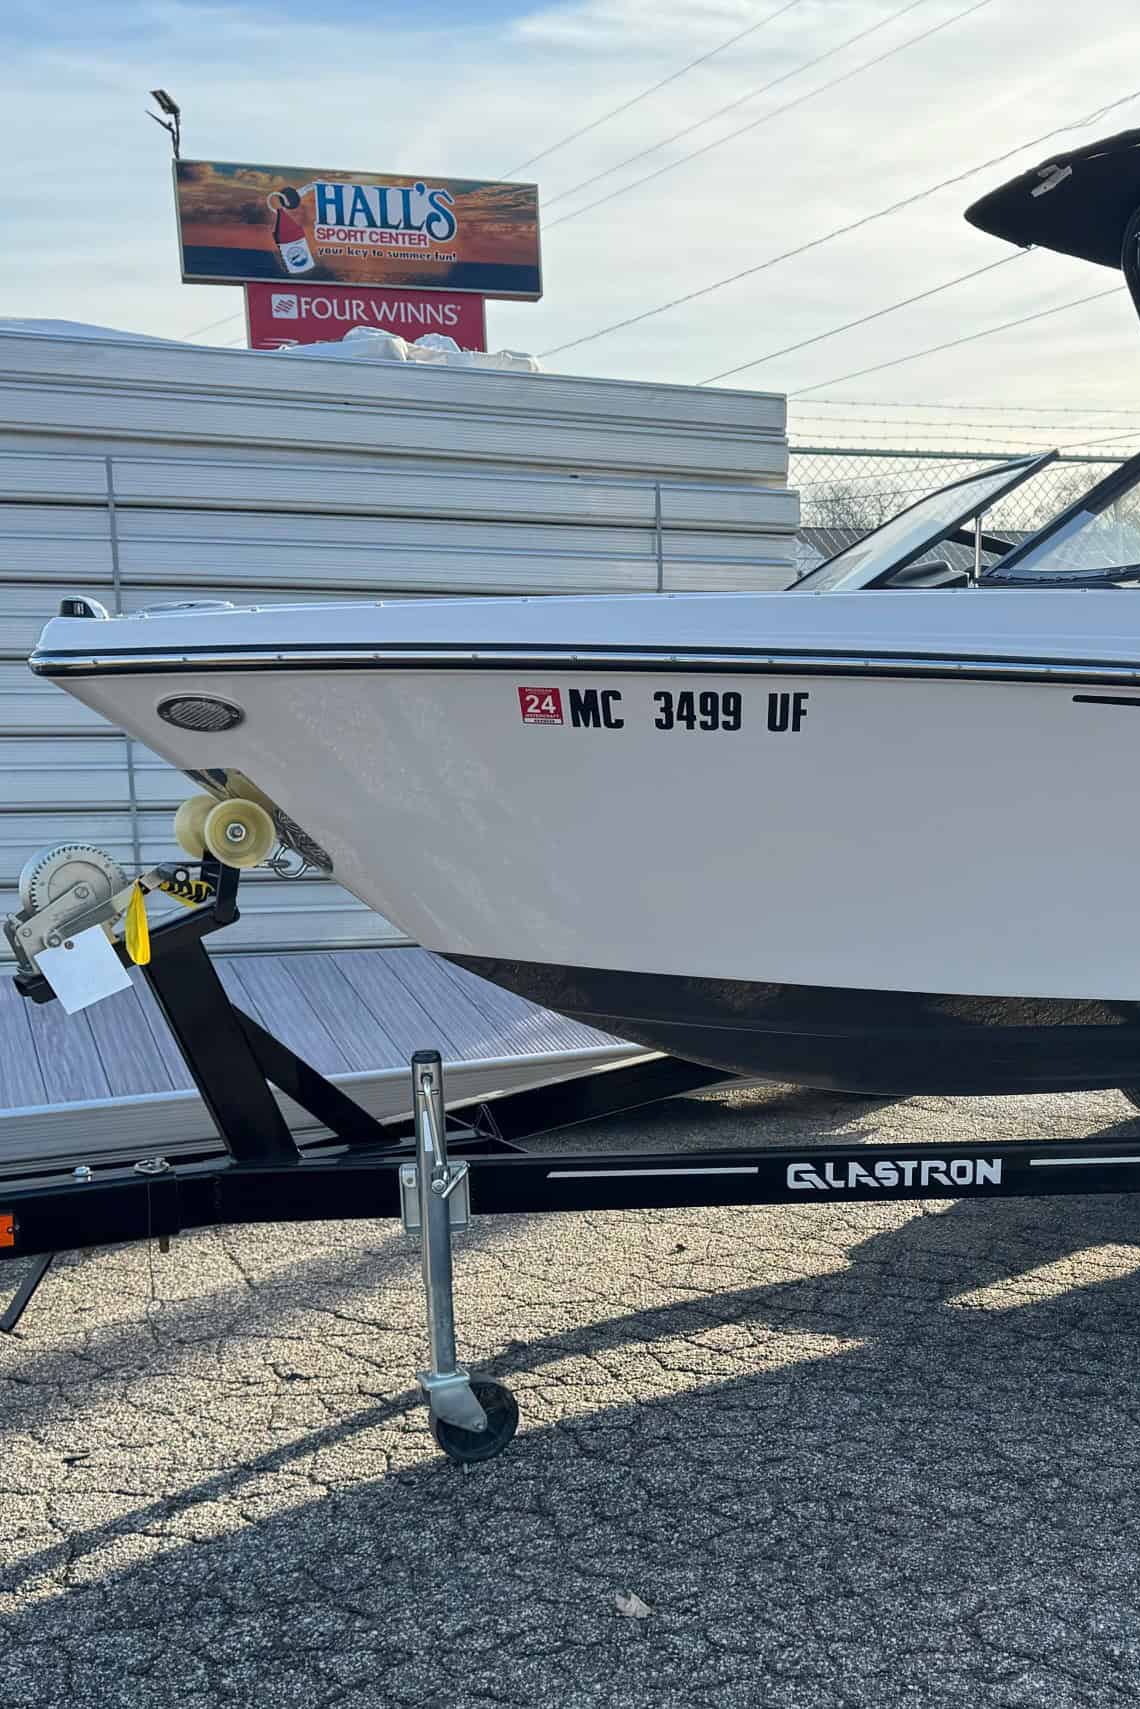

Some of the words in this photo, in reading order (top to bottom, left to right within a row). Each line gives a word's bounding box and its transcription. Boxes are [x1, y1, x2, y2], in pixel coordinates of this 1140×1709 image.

[315, 182, 456, 241] HALL'S
[316, 227, 368, 242] SPORT
[368, 230, 428, 246] CENTER
[318, 247, 343, 256] your
[347, 247, 368, 257] key
[373, 248, 383, 256] to
[388, 250, 431, 260] summer
[435, 250, 456, 261] fun!
[300, 297, 370, 321] FOUR
[370, 300, 459, 326] WINNS
[525, 694, 557, 713] 24
[568, 688, 625, 729] MC
[653, 691, 742, 731] 3499
[767, 692, 809, 732] UF
[786, 1158, 1002, 1190] GLASTRON
